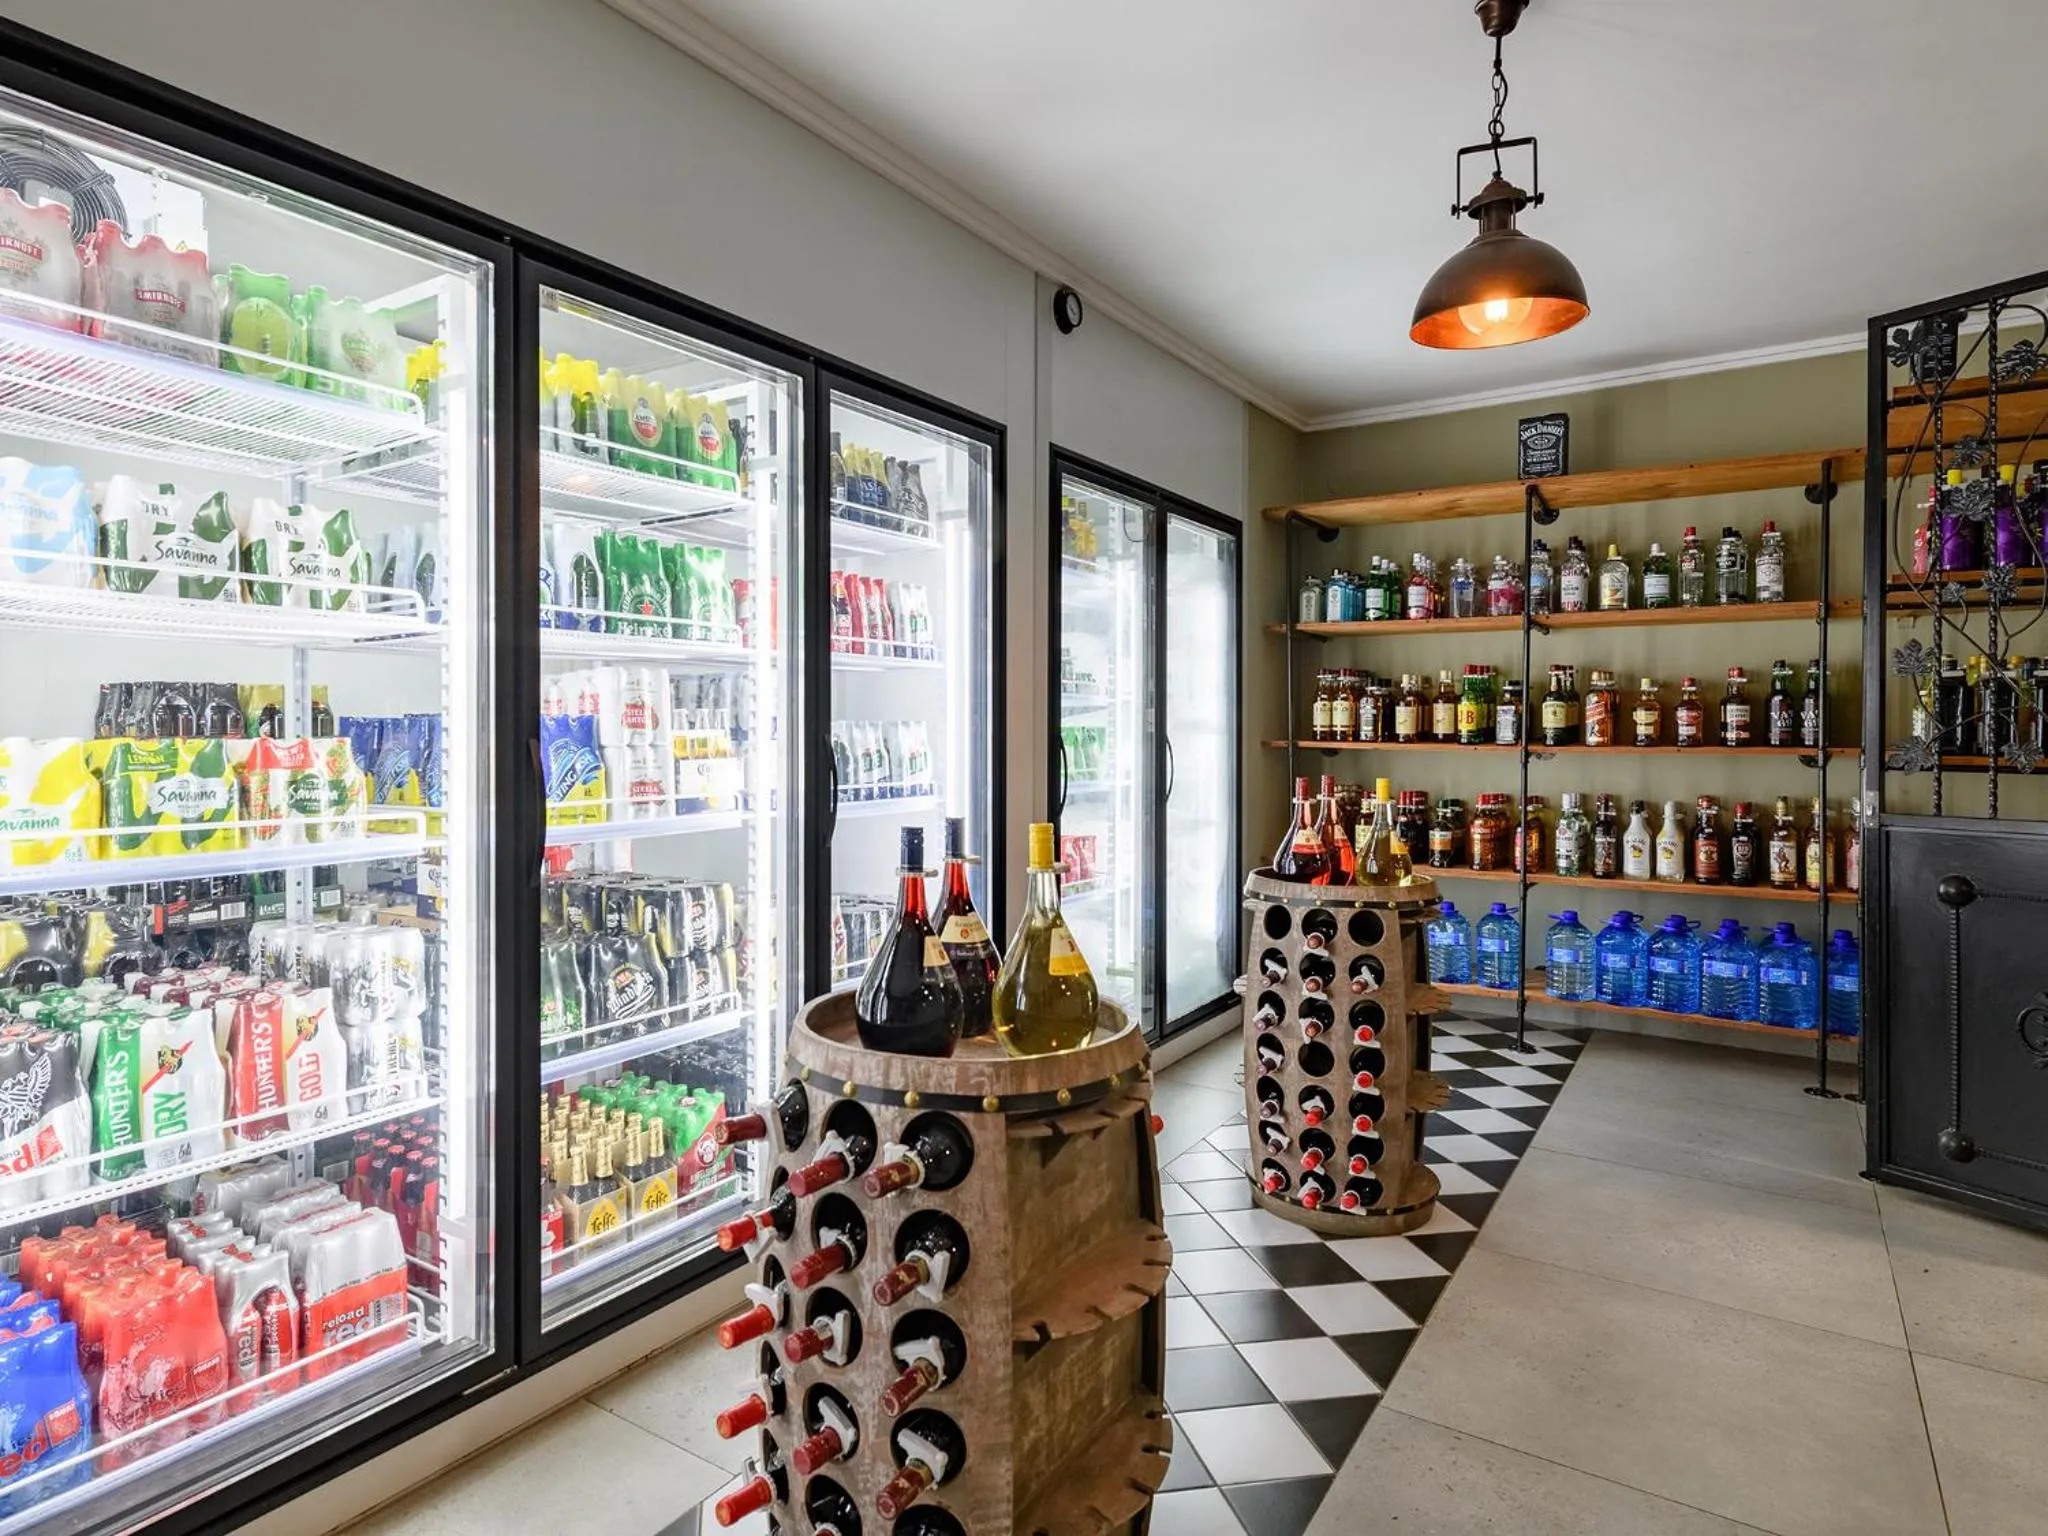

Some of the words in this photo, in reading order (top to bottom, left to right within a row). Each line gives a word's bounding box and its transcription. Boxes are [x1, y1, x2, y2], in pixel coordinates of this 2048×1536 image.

[154, 543, 217, 567] Savanna
[289, 557, 341, 579] Savana
[158, 786, 217, 807] Savanna
[153, 1091, 189, 1137] DRY
[322, 1305, 364, 1329] reload
